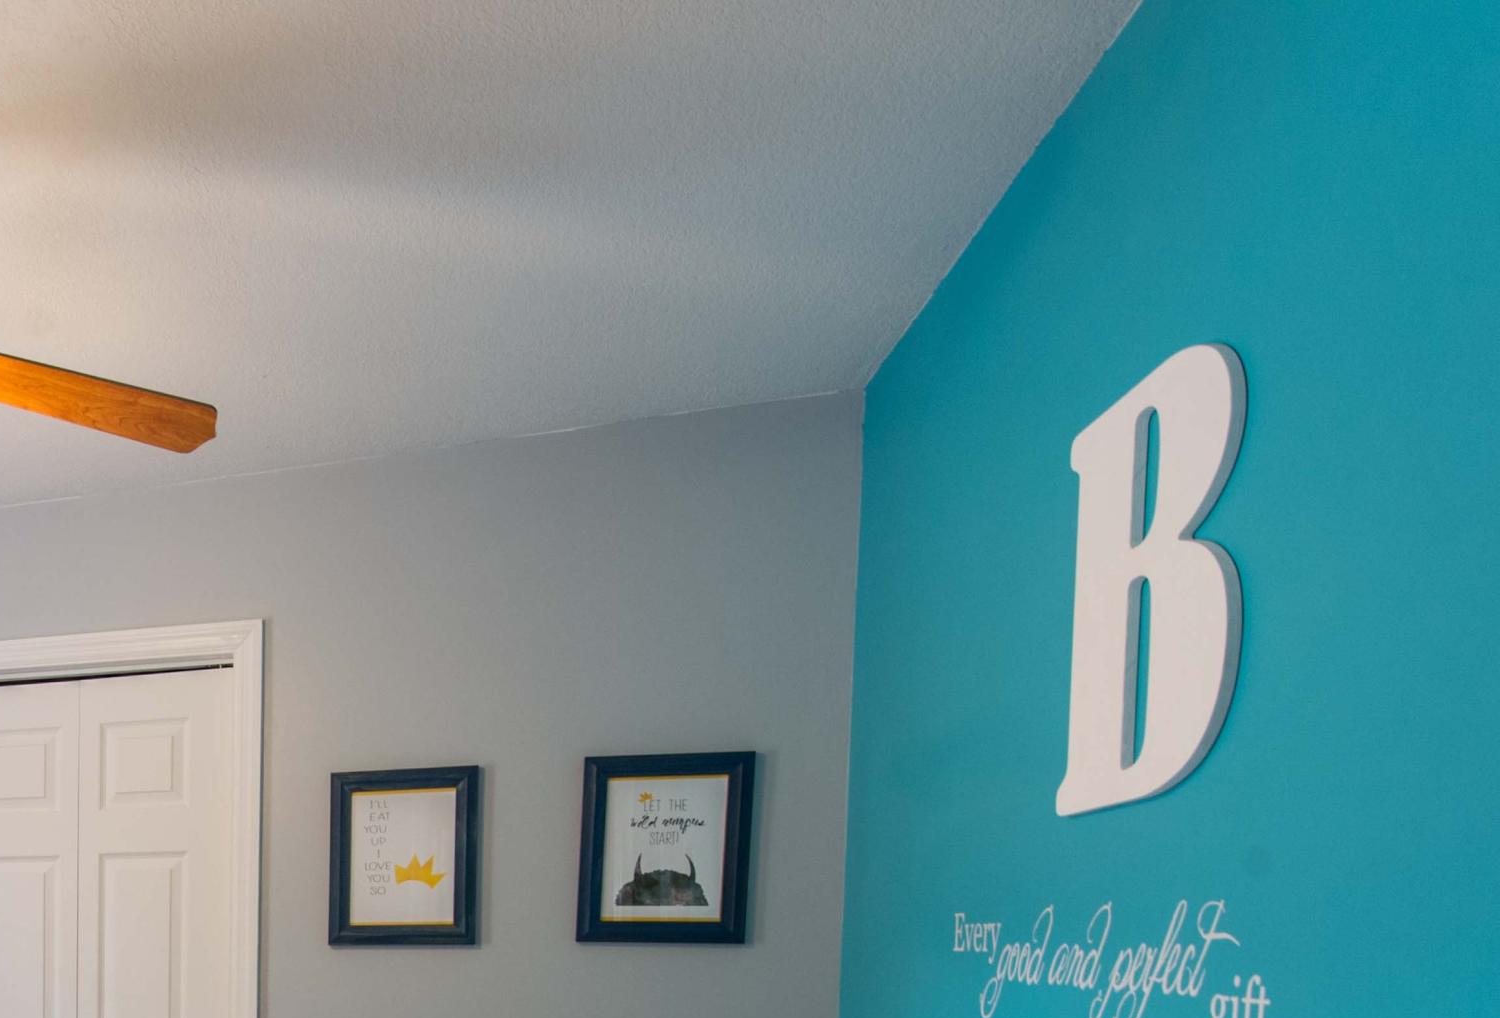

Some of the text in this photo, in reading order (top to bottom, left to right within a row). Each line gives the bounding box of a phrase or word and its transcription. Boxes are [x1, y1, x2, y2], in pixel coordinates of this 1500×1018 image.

[1055, 342, 1248, 817] B
[643, 799, 688, 812] LET THE
[369, 811, 390, 822] EAT
[363, 824, 388, 835] YOU
[370, 837, 387, 847] UP
[364, 861, 392, 872] LOVE
[367, 873, 391, 884] YOU
[370, 886, 387, 896] SO
[952, 912, 1001, 965] Every
[1047, 900, 1112, 990] and
